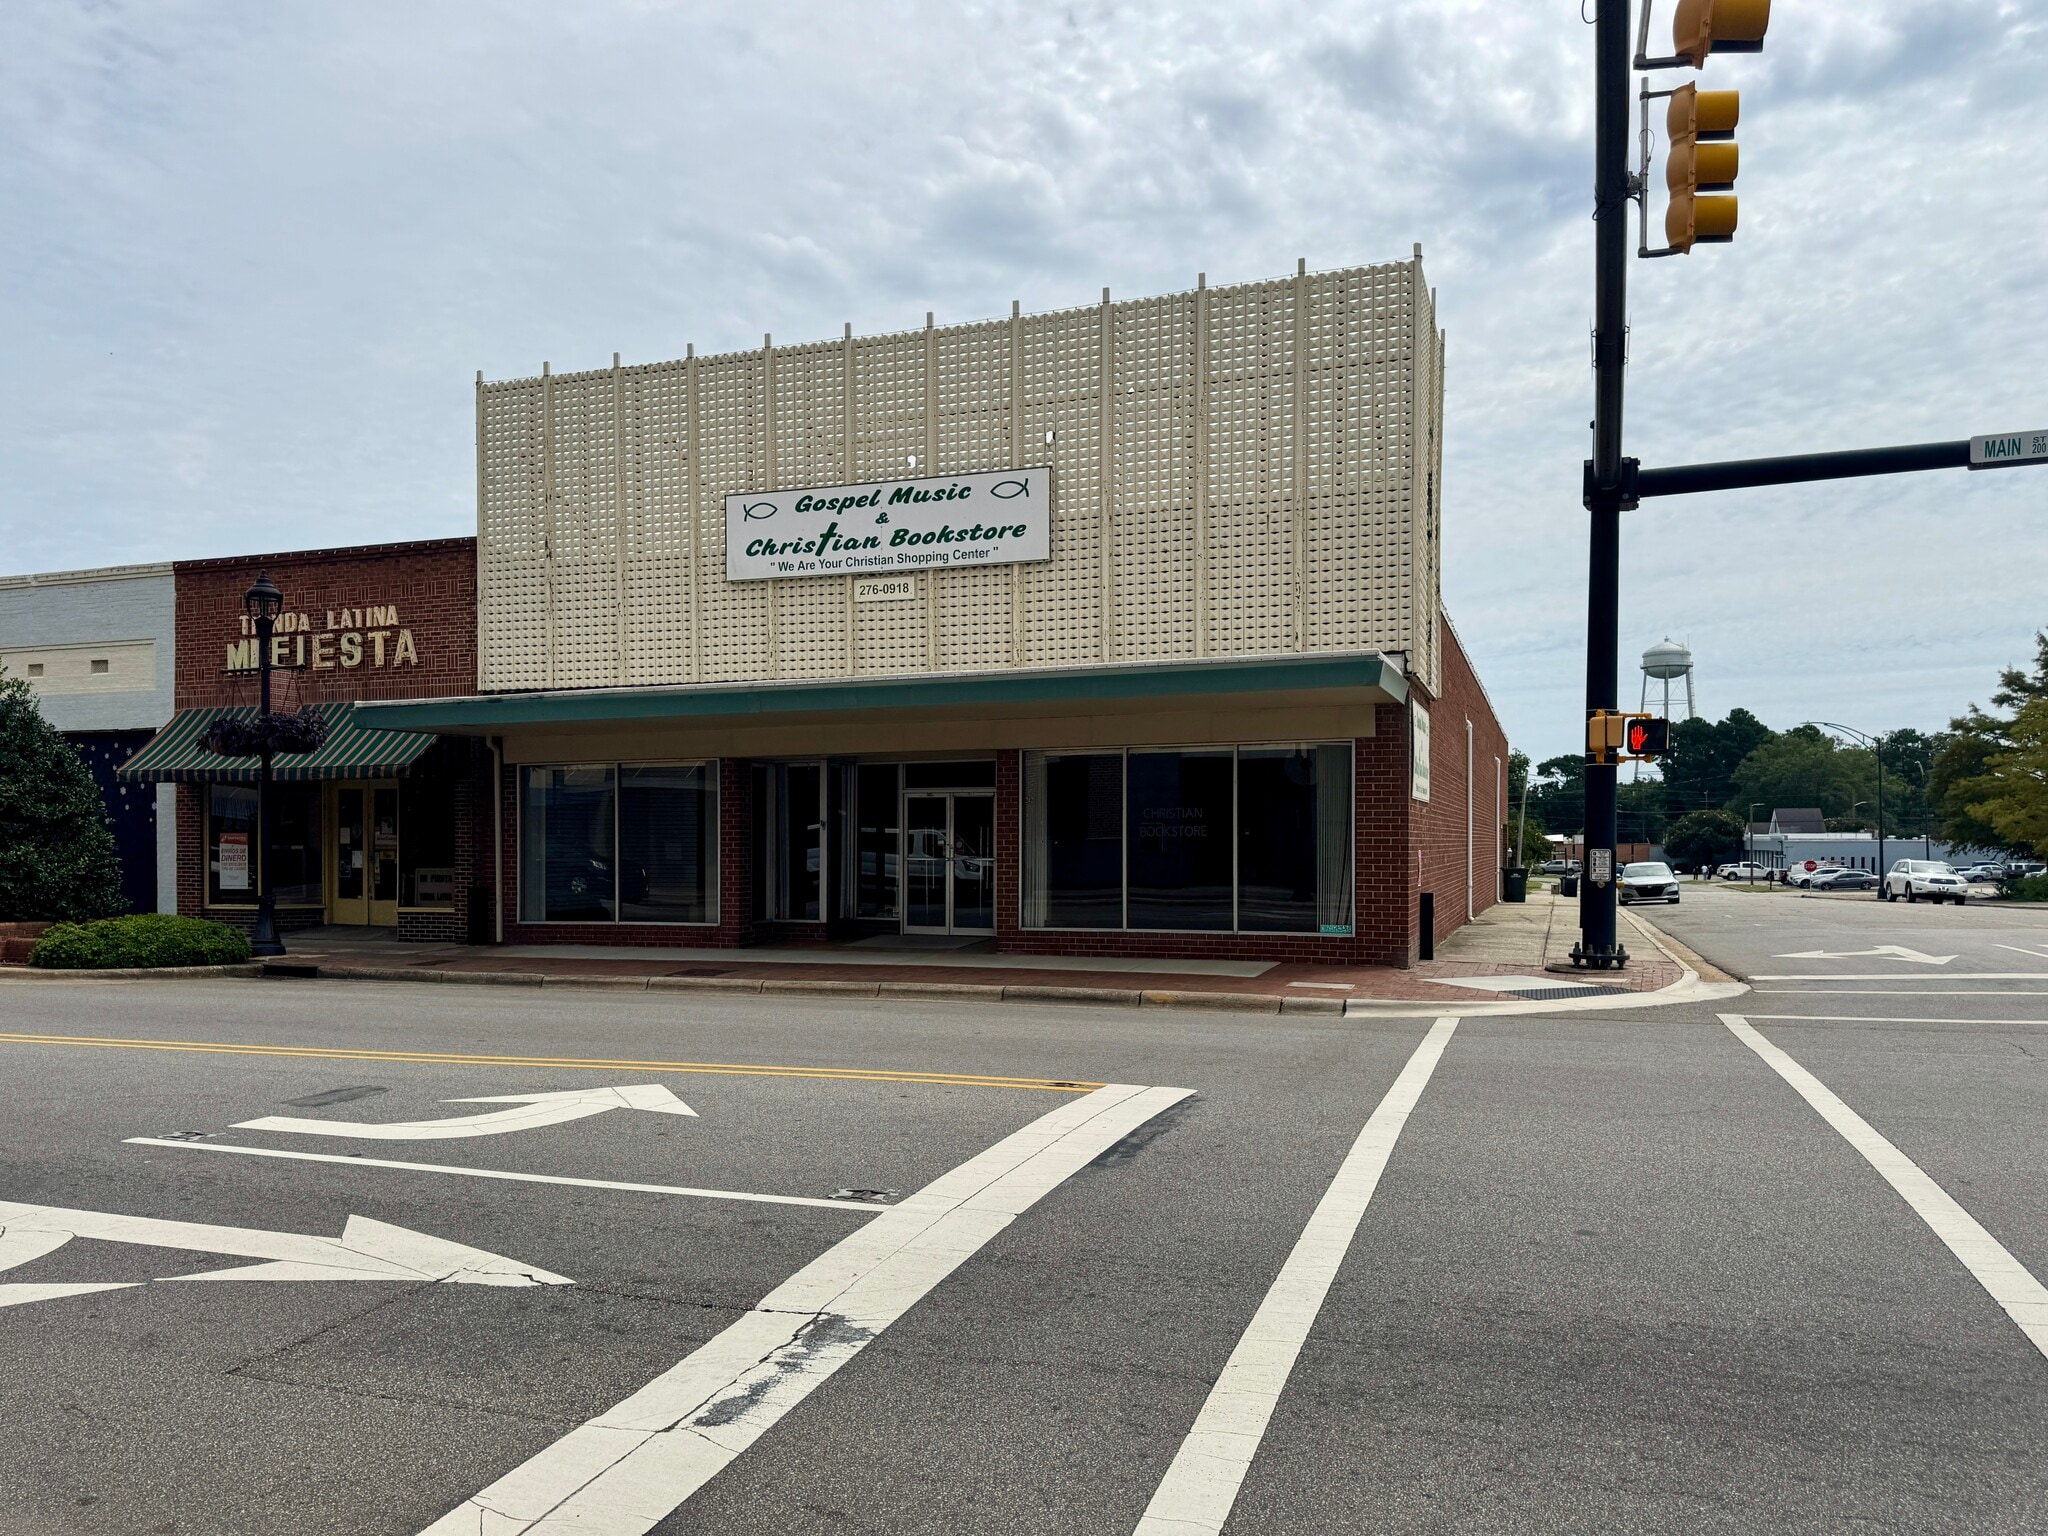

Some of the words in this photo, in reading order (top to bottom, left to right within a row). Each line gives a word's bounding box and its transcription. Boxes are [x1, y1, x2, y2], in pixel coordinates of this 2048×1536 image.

[1985, 438, 2021, 458] MAIN
[2032, 443, 2047, 454] 200
[795, 489, 882, 515] Gospel
[888, 483, 971, 505] Music
[875, 512, 889, 524] &
[746, 522, 881, 557] Christian
[889, 523, 1027, 547] Bookstore
[797, 560, 815, 570] Are
[819, 557, 842, 569] Your
[845, 554, 894, 568] Christian
[897, 550, 949, 564] Shopping
[859, 583, 909, 596] 276-0918
[239, 612, 311, 635] TINDA
[327, 605, 400, 629] LATINA
[227, 638, 260, 675] MI
[271, 629, 419, 670] FIESTA
[1143, 807, 1203, 819] CHRISTIAN
[1140, 825, 1208, 837] BOOKSTORE
